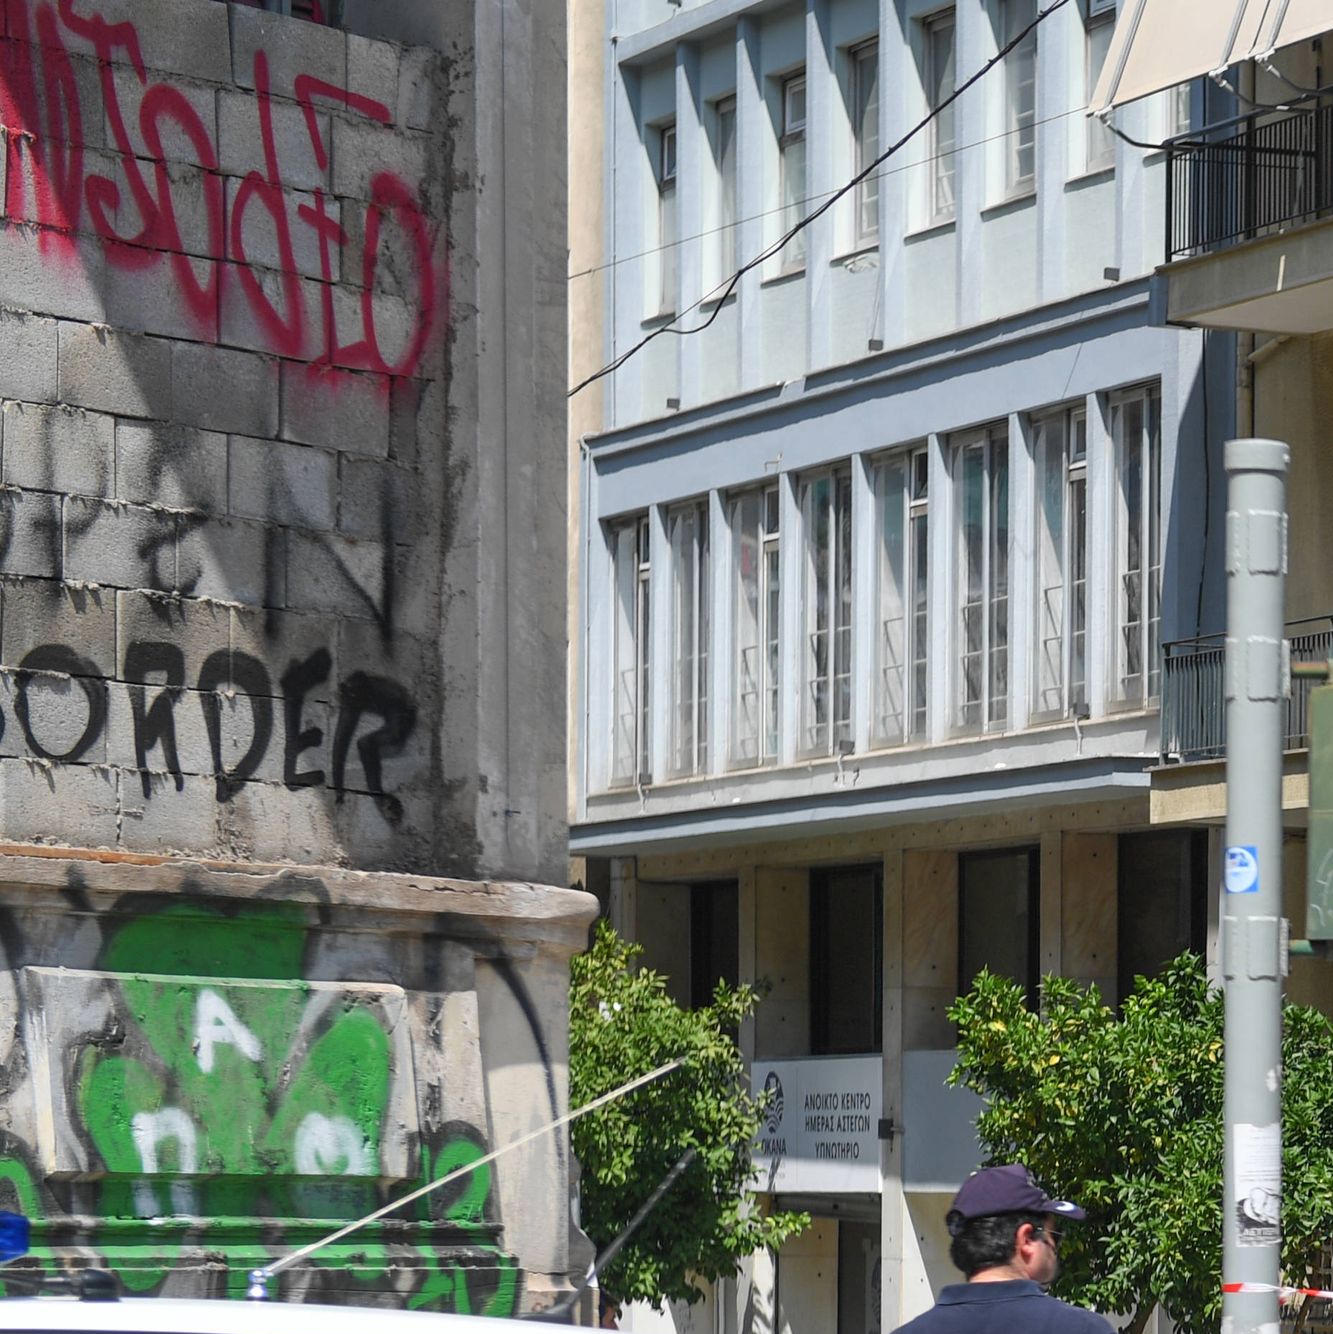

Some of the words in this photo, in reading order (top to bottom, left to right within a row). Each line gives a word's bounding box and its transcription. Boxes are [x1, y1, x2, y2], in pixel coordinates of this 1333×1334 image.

[0, 641, 418, 818] ORDER
[804, 1093, 838, 1111] ΑΝΟΙΚΤΟ
[841, 1092, 871, 1110] ΚΕΝΤΡΟ
[805, 1116, 834, 1133] ΗΜΕΡΑΣ
[836, 1115, 870, 1133] ΑΣΤΕΓΩΝ
[815, 1142, 860, 1160] ΥΠΝΩΤΗΡΙΟ
